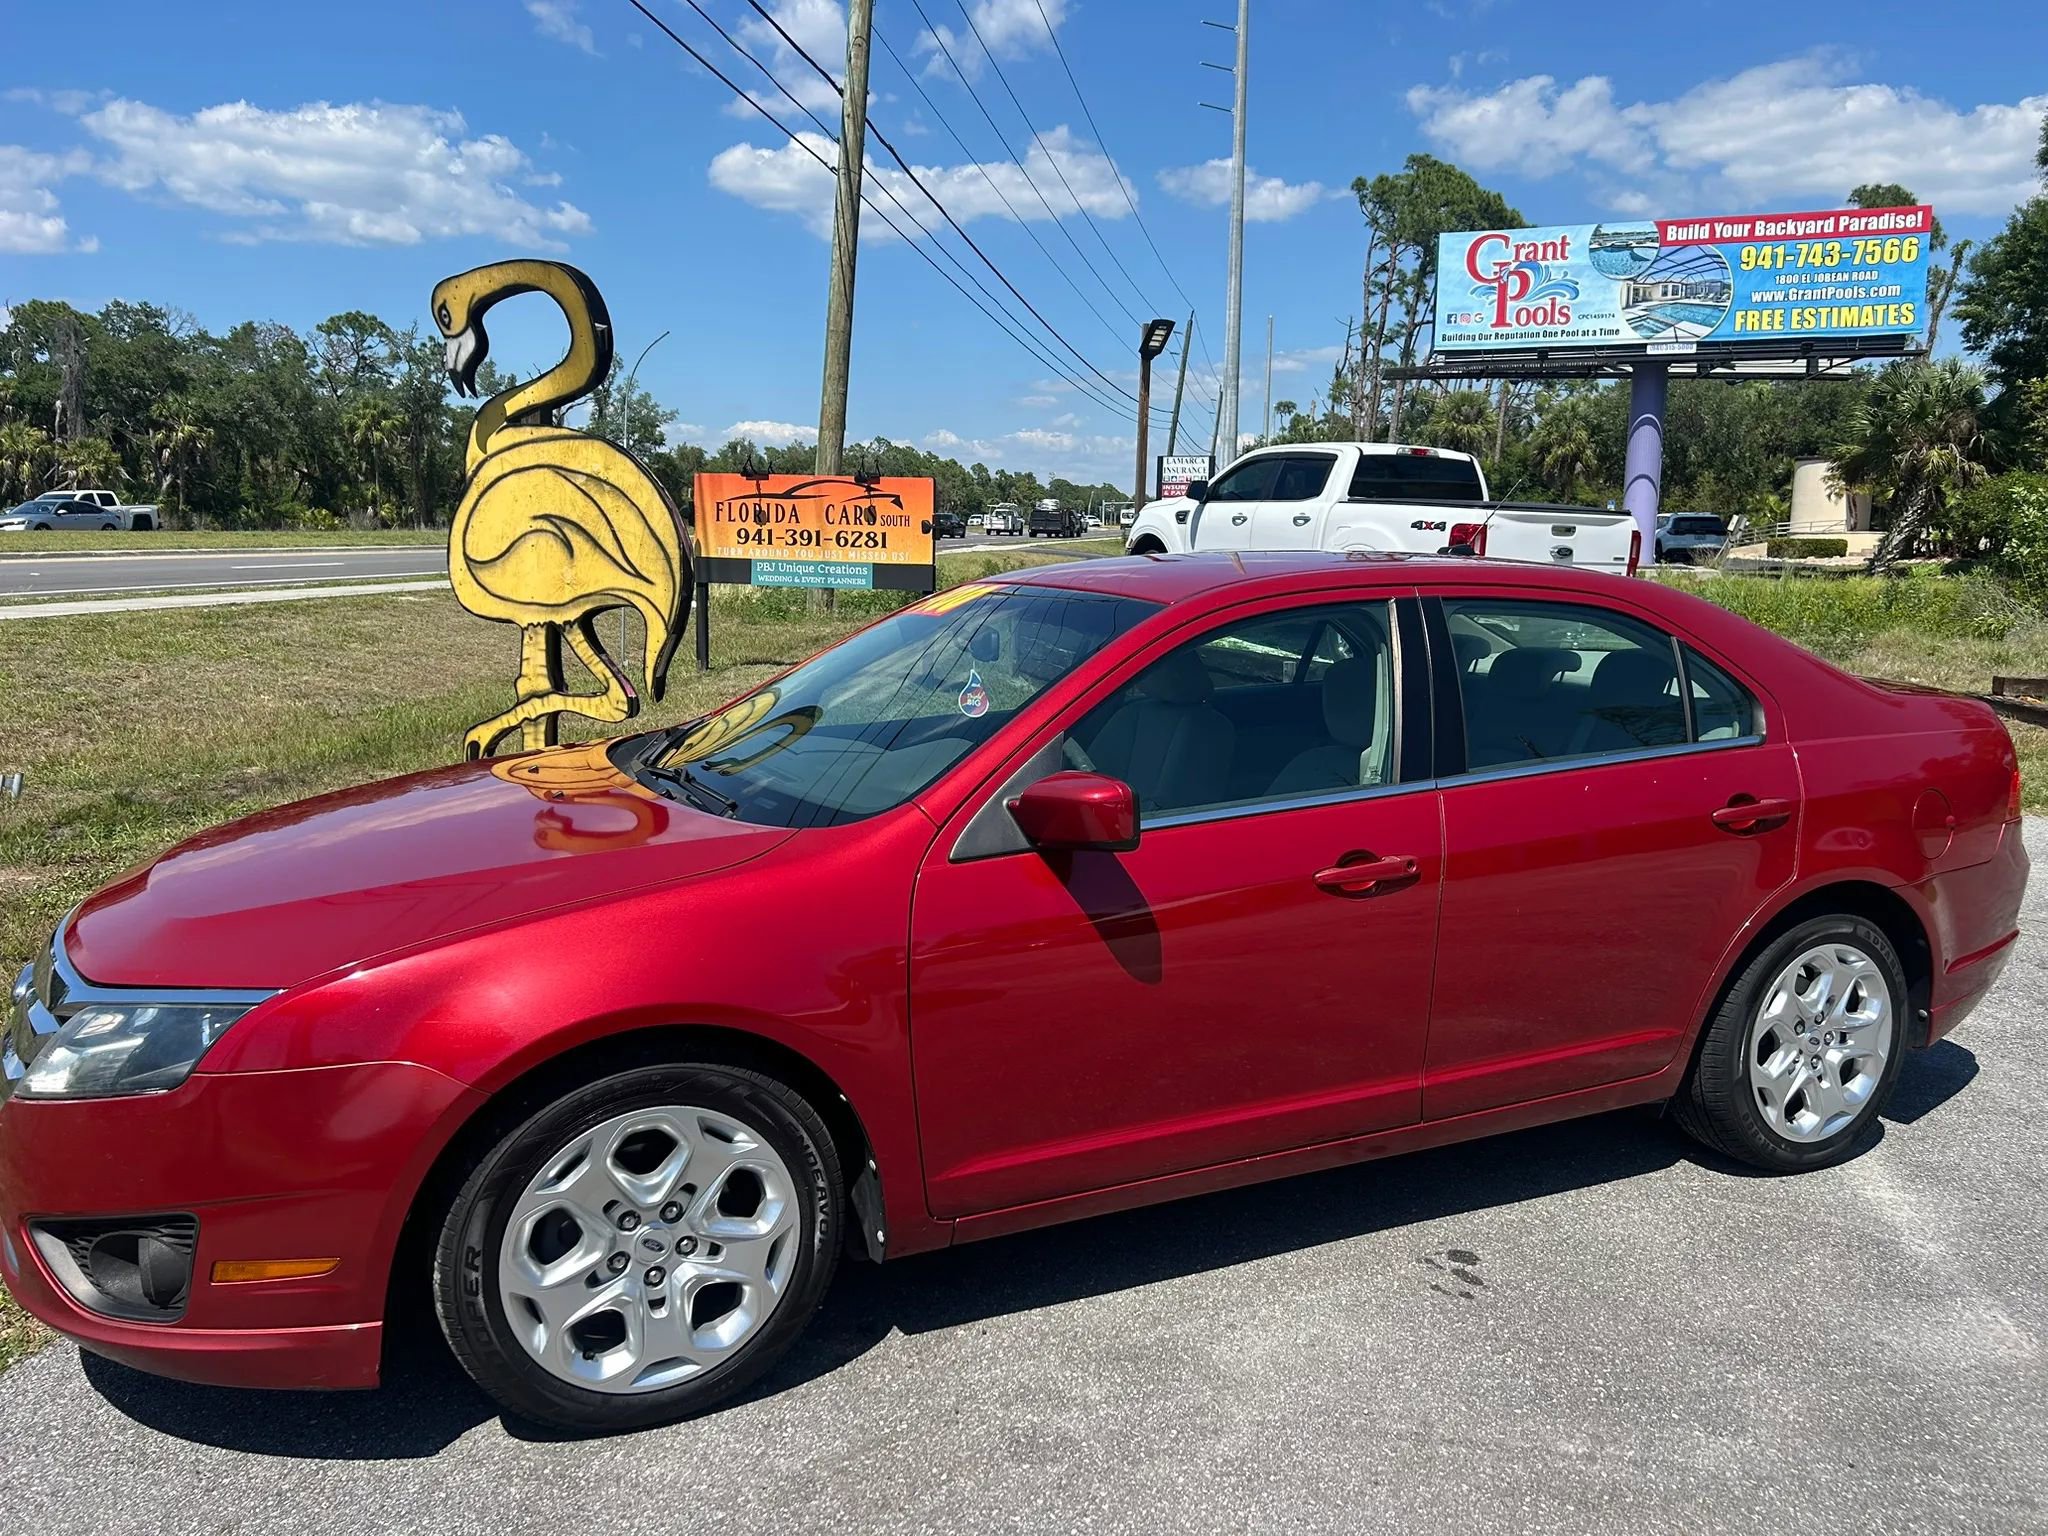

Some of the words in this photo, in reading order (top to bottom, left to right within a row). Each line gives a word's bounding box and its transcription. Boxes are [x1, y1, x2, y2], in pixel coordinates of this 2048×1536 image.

[1666, 223, 1710, 242] Build
[1713, 220, 1751, 239] Your
[1754, 217, 1836, 238] Backyard
[1838, 210, 1923, 232] Paradise!
[1466, 233, 1571, 284] Grant
[1739, 236, 1920, 272] 941-743-7566
[1775, 274, 1799, 285] 1800
[1801, 273, 1813, 284] EL
[1813, 272, 1850, 284] JOBEAN
[1851, 271, 1878, 282] ROAD
[1490, 262, 1571, 329] Pools
[1750, 283, 1901, 304] www.GrantPools.com
[1734, 308, 1785, 333] FREE
[1790, 302, 1916, 331] ESTIMATES
[1441, 333, 1476, 342] Building
[1478, 333, 1493, 342] Our
[1494, 330, 1540, 342] Reputation
[1542, 329, 1558, 339] One
[1560, 329, 1580, 338] Pool
[1581, 328, 1590, 337] at
[1599, 327, 1620, 337] Time
[1163, 466, 1207, 474] INSURANCE
[715, 502, 800, 524] FLORIDA
[825, 504, 877, 526] CARS
[880, 514, 910, 527] SOUTH
[736, 528, 887, 549] 941-391-6281
[717, 547, 743, 557] TURN
[749, 548, 789, 558] AROUND
[794, 549, 814, 559] YOU
[818, 550, 844, 560] JUST
[848, 551, 887, 561] MISSED
[756, 562, 776, 573] PBJ
[778, 563, 815, 575] Unique
[817, 564, 868, 575] Creations
[758, 575, 793, 583] WEDDING
[801, 576, 826, 584] EVENT
[827, 577, 866, 585] PLANNERS
